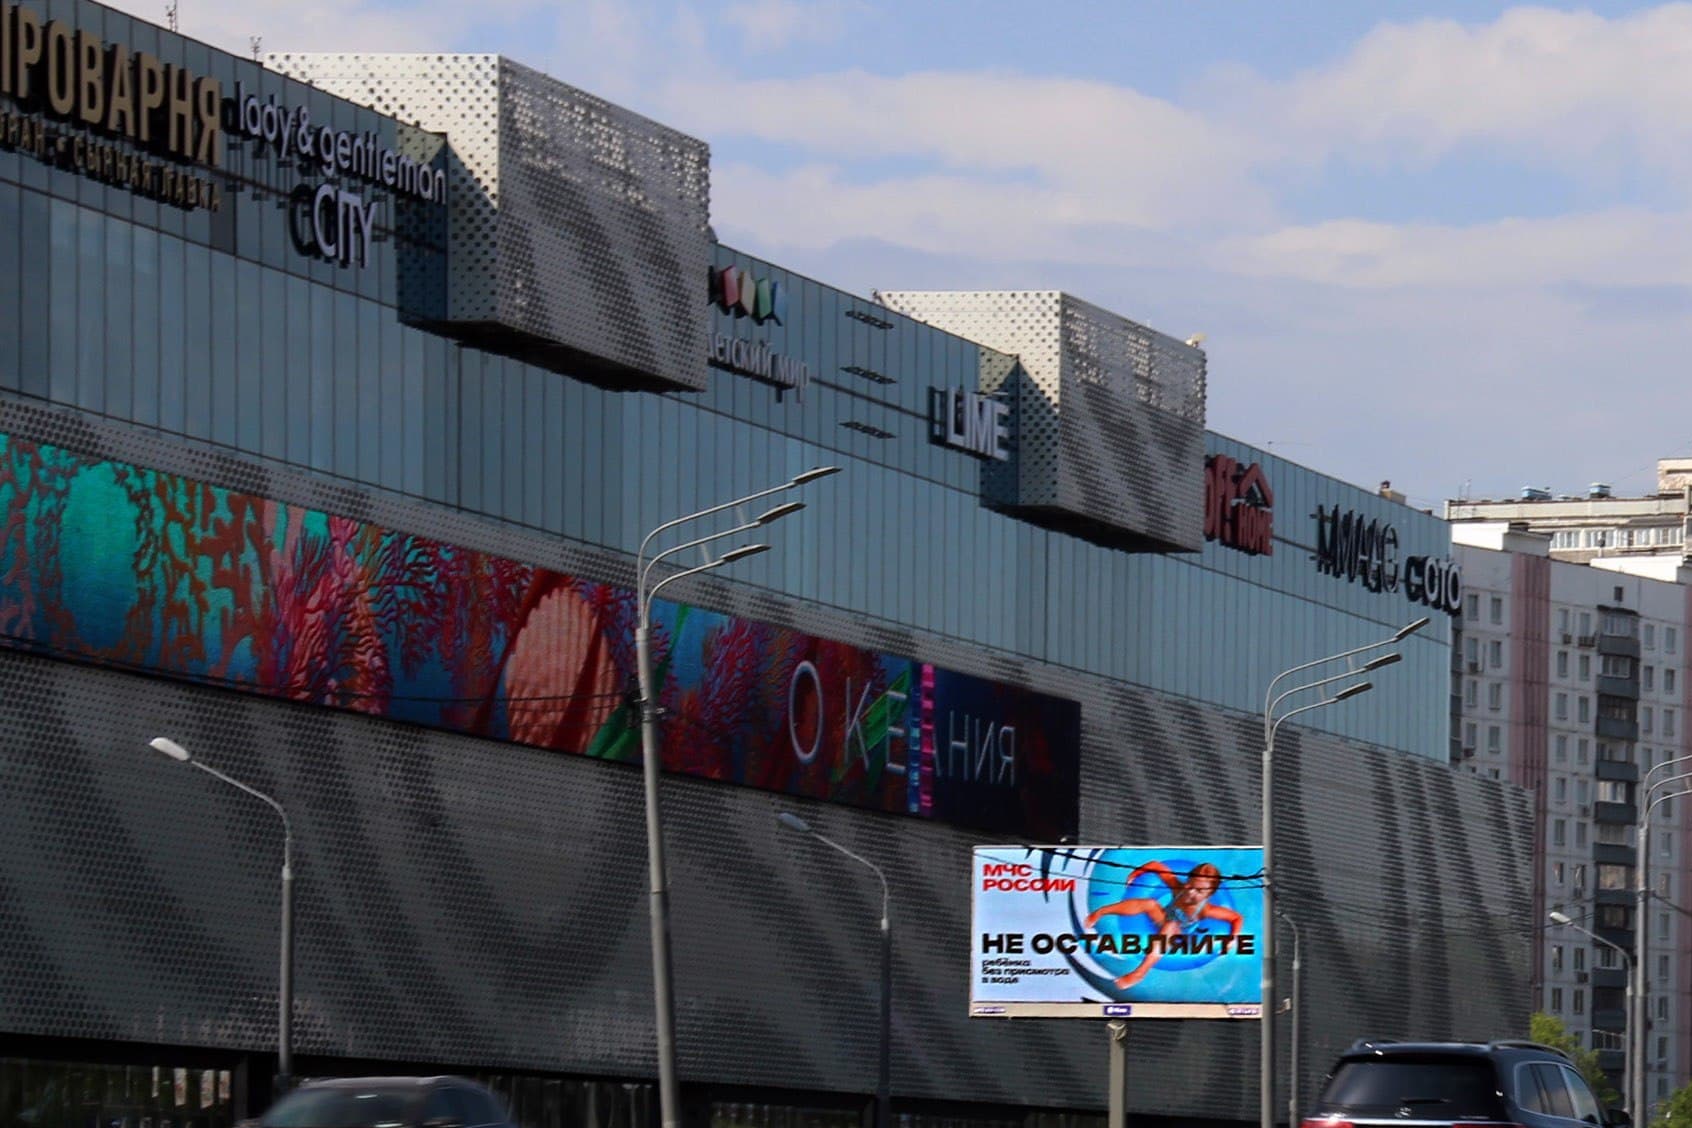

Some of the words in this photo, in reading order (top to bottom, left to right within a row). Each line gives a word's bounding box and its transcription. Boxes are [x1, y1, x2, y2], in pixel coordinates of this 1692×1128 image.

[239, 80, 293, 158] lady
[319, 126, 446, 204] gentleman
[313, 183, 378, 269] CITY
[946, 385, 1009, 461] LIME
[788, 660, 1016, 787] ОКЕНИЯ
[982, 863, 1032, 877] МЧС
[982, 878, 1075, 892] РОССИИ
[981, 933, 1024, 955] НЕ
[1031, 929, 1255, 955] ОСТАВЛЯЙТЕ
